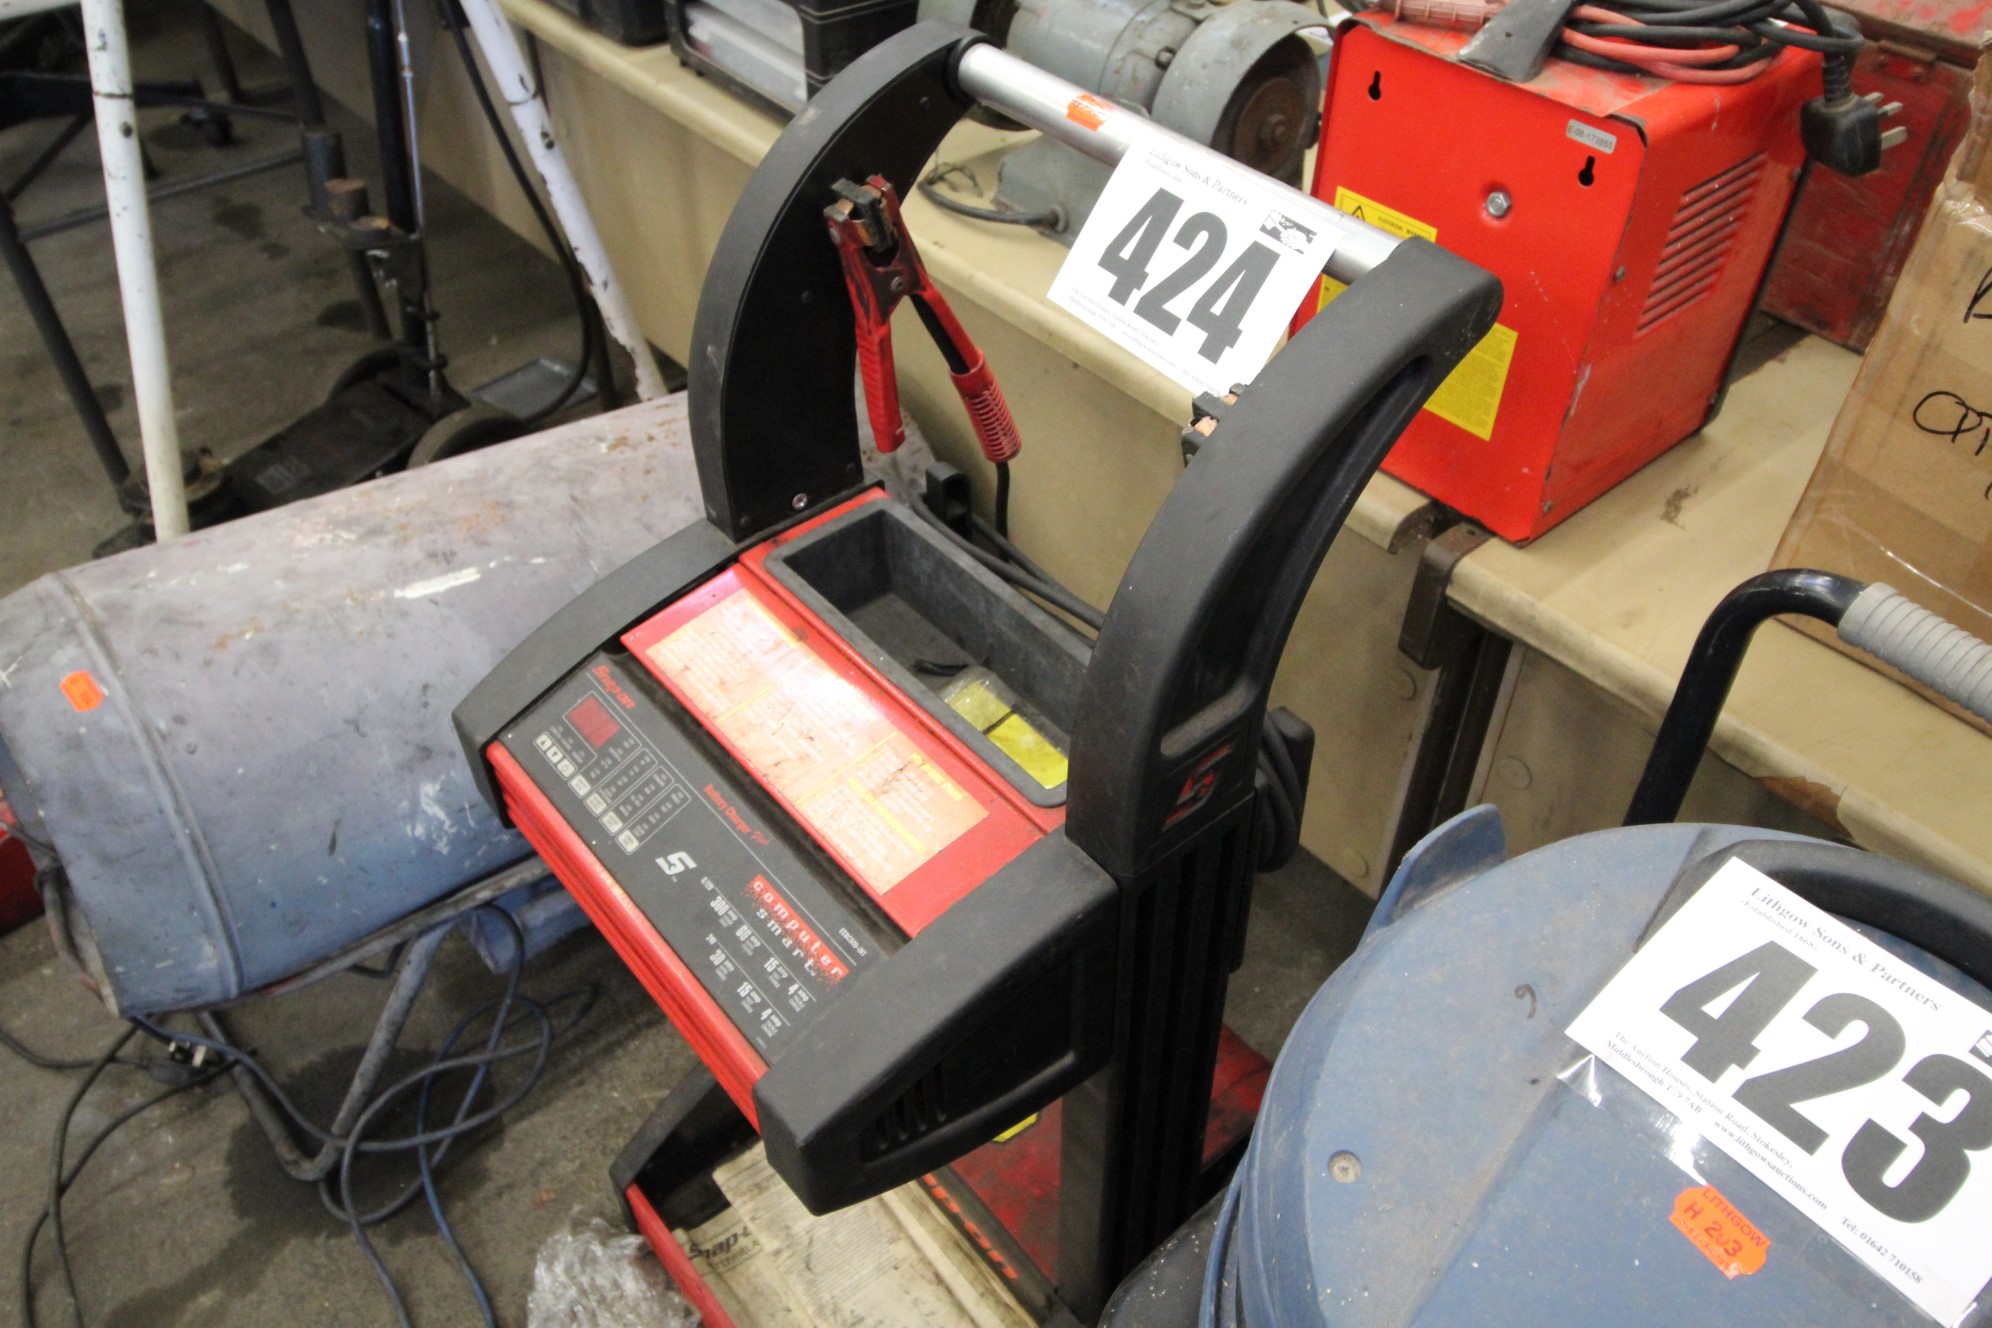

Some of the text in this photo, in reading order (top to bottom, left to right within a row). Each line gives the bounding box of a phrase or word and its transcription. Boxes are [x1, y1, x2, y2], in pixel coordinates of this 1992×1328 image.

[1097, 187, 1281, 365] 424
[709, 895, 730, 917] 300
[735, 925, 751, 941] 60
[753, 879, 844, 977] computer
[756, 908, 813, 972] smart
[708, 948, 726, 967] 30
[763, 956, 777, 973] 15
[1750, 887, 1941, 1012] Lithgow Sons & Partners
[736, 981, 752, 998] 15
[788, 983, 799, 996] 4
[760, 1008, 772, 1021] 4
[1614, 1031, 1630, 1045] The
[1694, 1089, 1724, 1116] Station
[1724, 1112, 1750, 1136] Road,
[1659, 940, 1992, 1224] 423
[1606, 1040, 1665, 1087] Middlesbrough
[1713, 1120, 1828, 1210] www.lithgowsauctions.com
[1841, 1216, 1860, 1235] Tel:
[1859, 1232, 1889, 1257] 01642
[1889, 1254, 1924, 1284] 710158
[1683, 1200, 1704, 1221] H
[1701, 1185, 1766, 1248] LITHGOW
